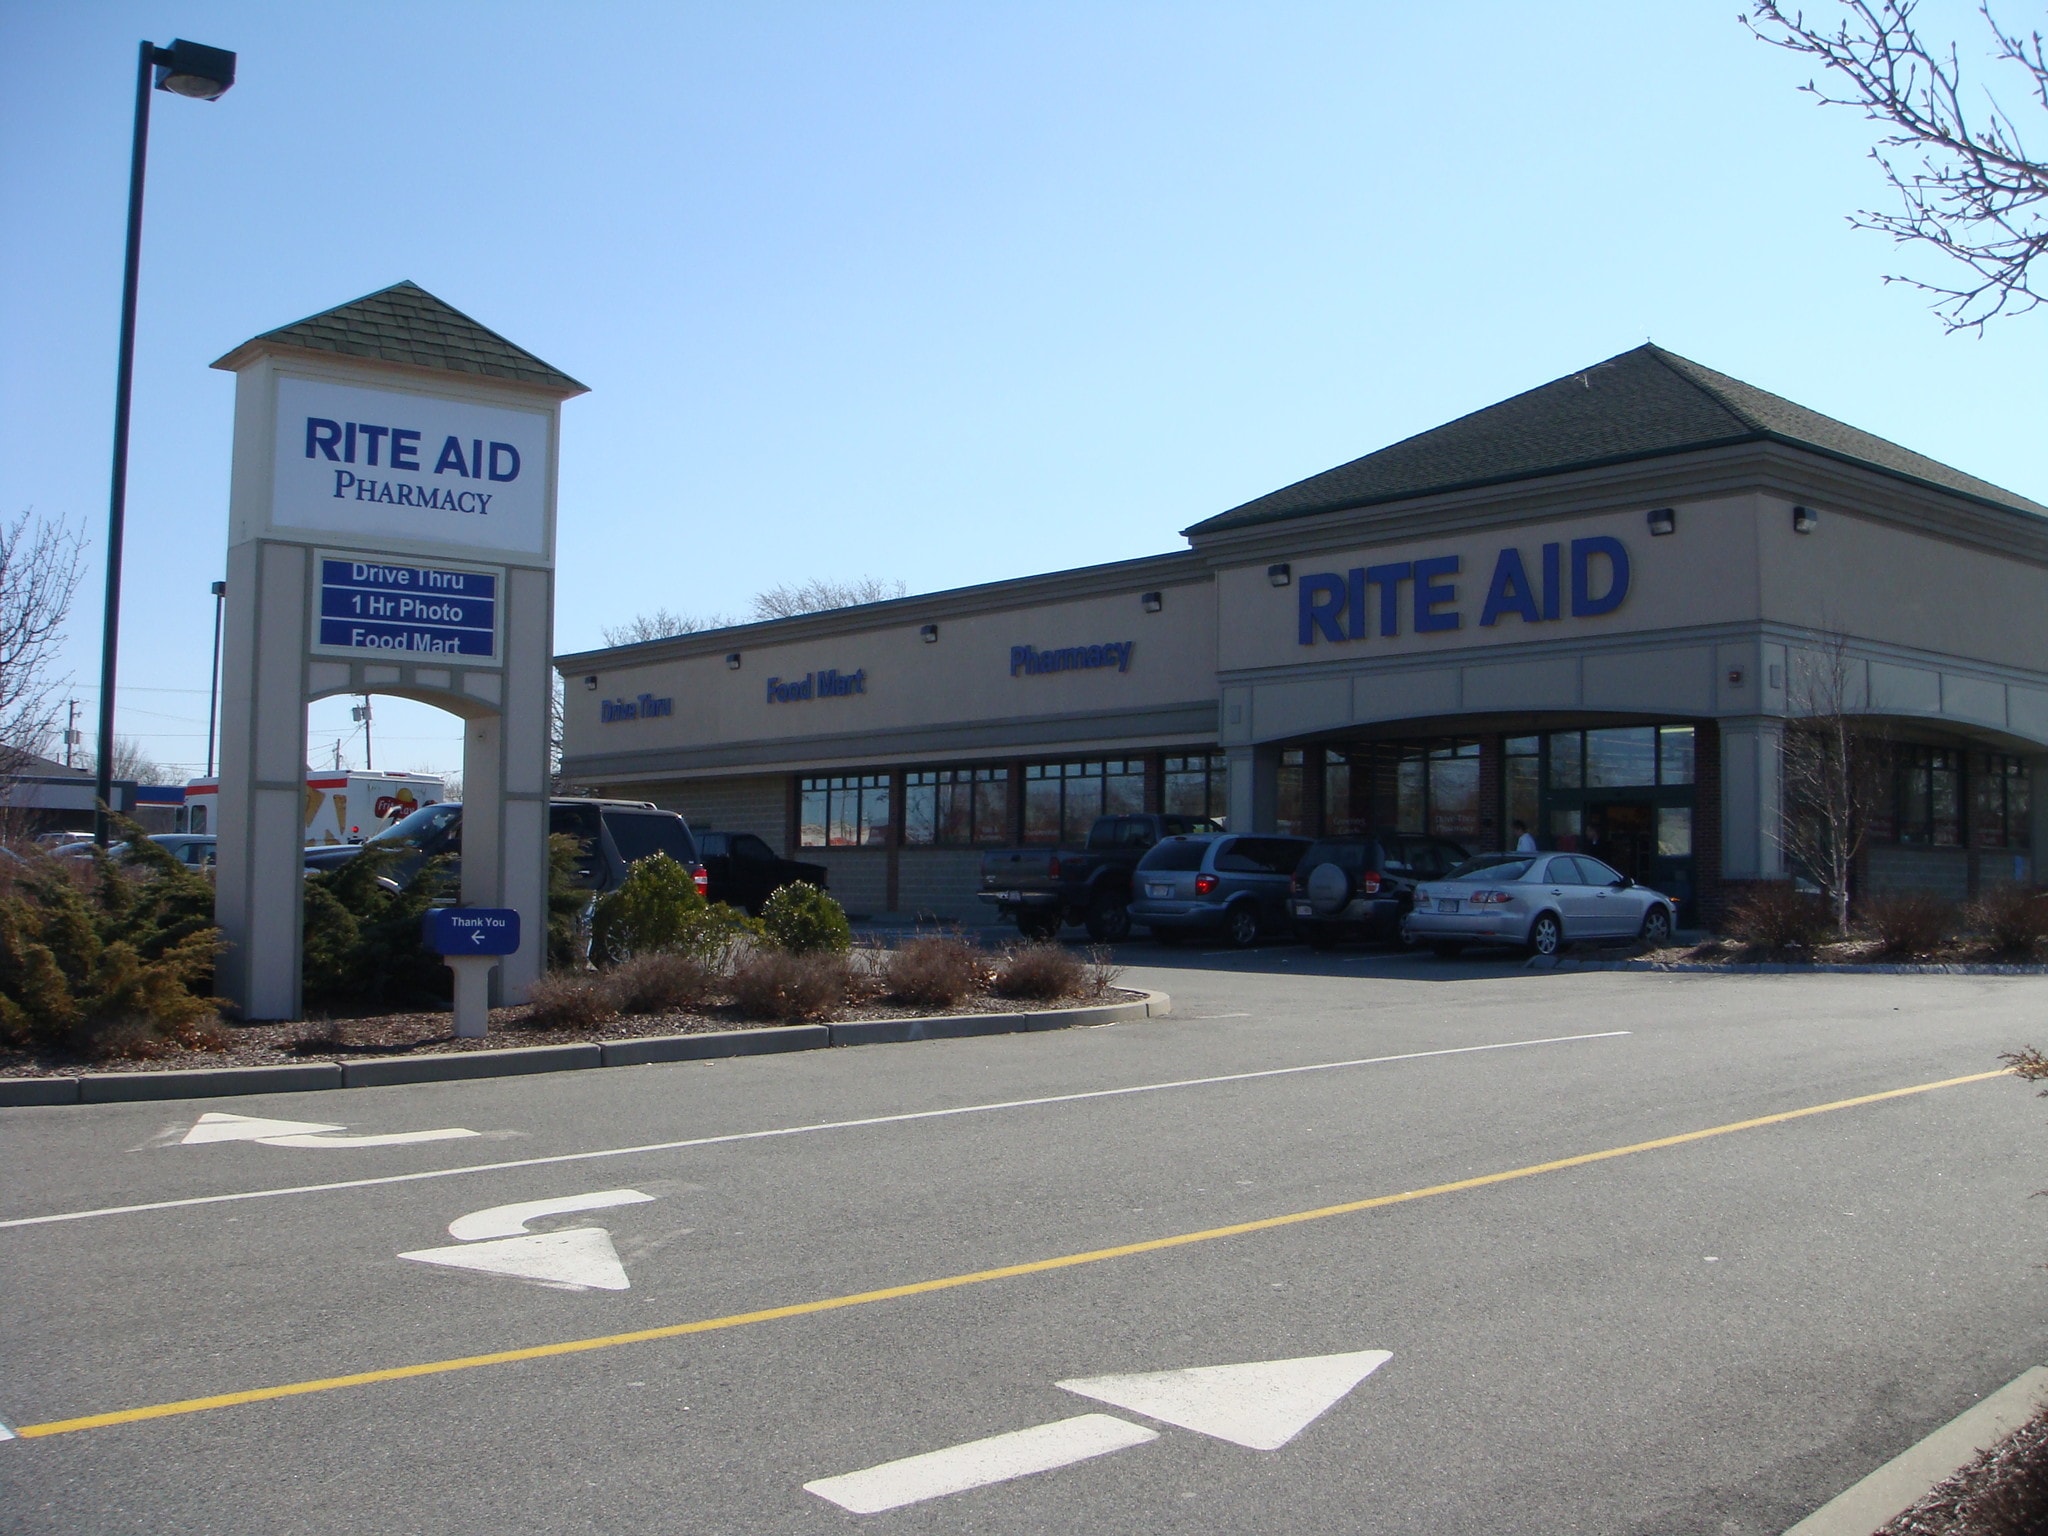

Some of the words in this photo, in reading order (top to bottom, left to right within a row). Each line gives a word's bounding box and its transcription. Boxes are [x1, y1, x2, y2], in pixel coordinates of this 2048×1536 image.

[305, 417, 421, 472] RITE
[434, 435, 521, 483] AID
[352, 563, 410, 585] Drive
[415, 568, 464, 590] Thru
[1299, 555, 1460, 646] RITE
[1479, 536, 1630, 627] AID
[352, 594, 361, 614] 1
[369, 596, 395, 617] Hr
[400, 598, 463, 622] Photo
[352, 628, 408, 650] Food
[413, 632, 461, 655] Mart
[1010, 641, 1133, 677] Pharmacy
[767, 672, 812, 704] Food
[817, 668, 865, 698] Mart
[600, 698, 636, 723] Drive
[637, 693, 673, 719] Thru
[451, 916, 484, 927] Thank
[485, 917, 506, 927] You
